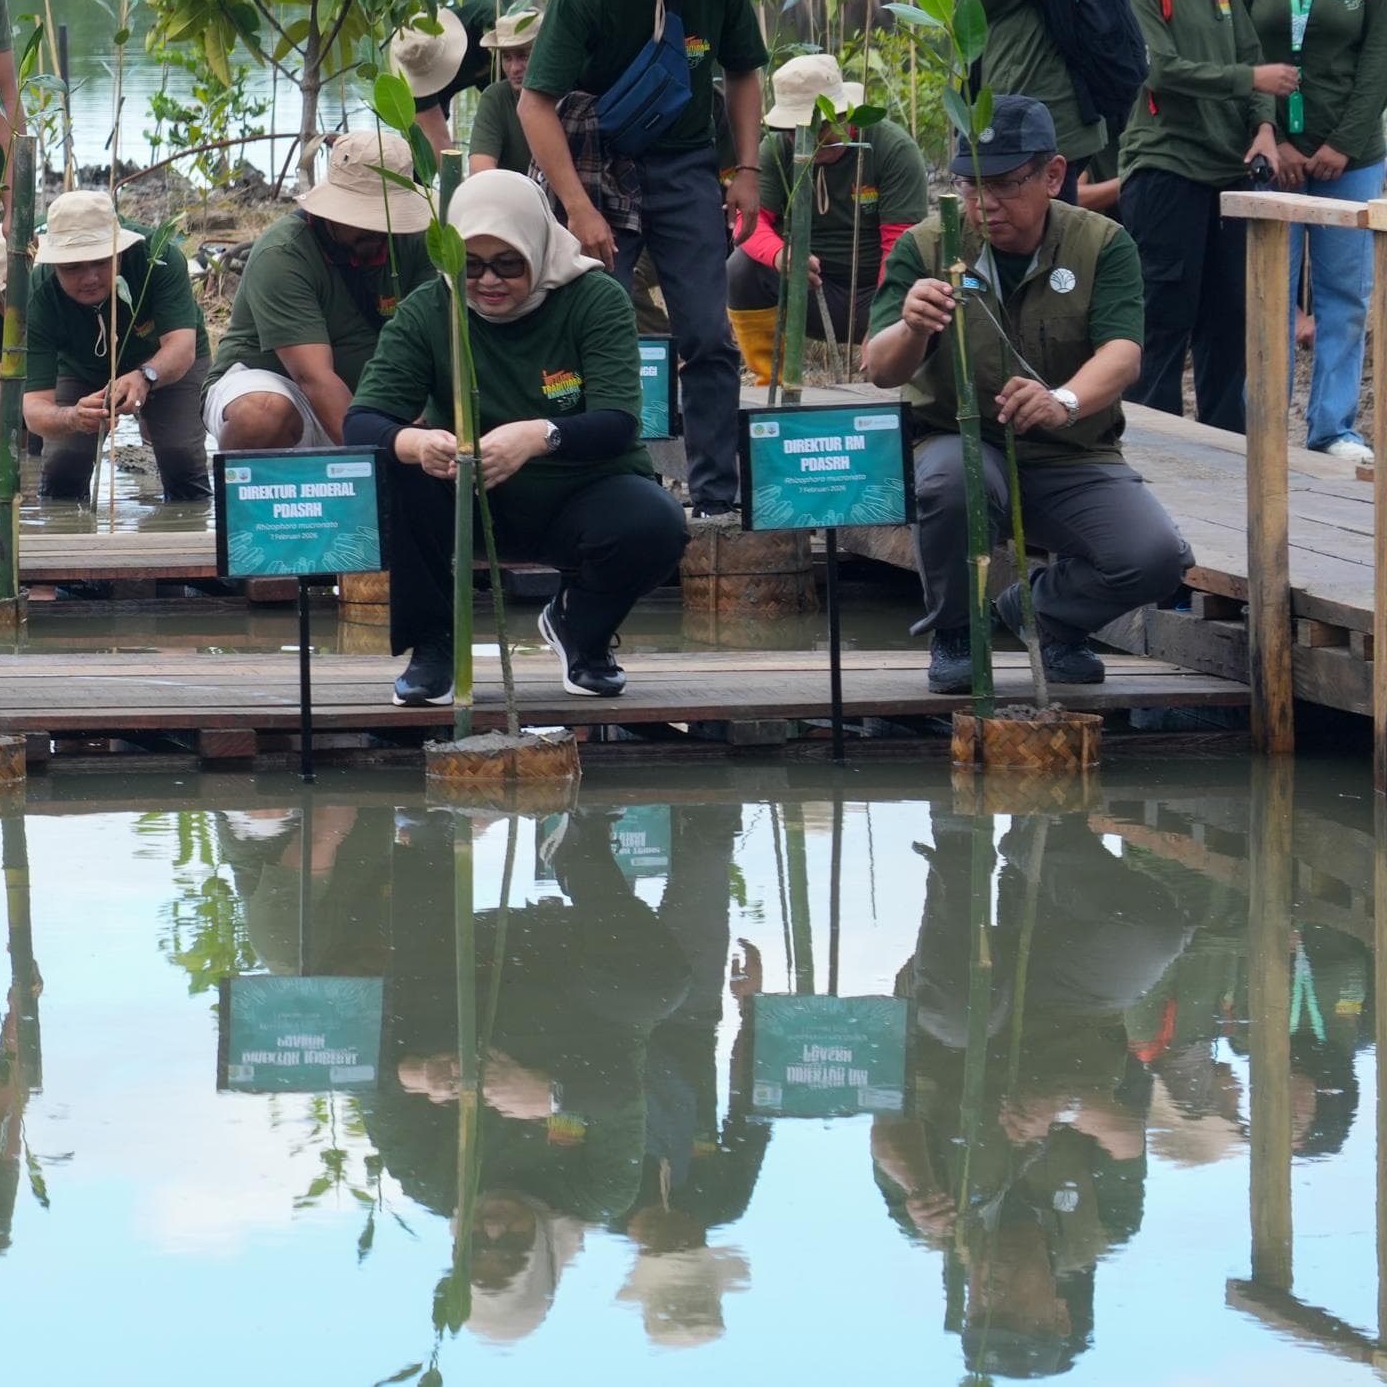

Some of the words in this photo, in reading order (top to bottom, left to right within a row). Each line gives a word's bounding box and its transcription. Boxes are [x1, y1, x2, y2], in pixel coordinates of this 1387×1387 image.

[783, 437, 843, 454] DIREKTUR
[845, 436, 865, 451] RM
[801, 456, 850, 472] PDASRH
[239, 484, 297, 500] DIREKTUR
[300, 482, 356, 498] JENDERAL
[273, 503, 323, 518] PDASRH
